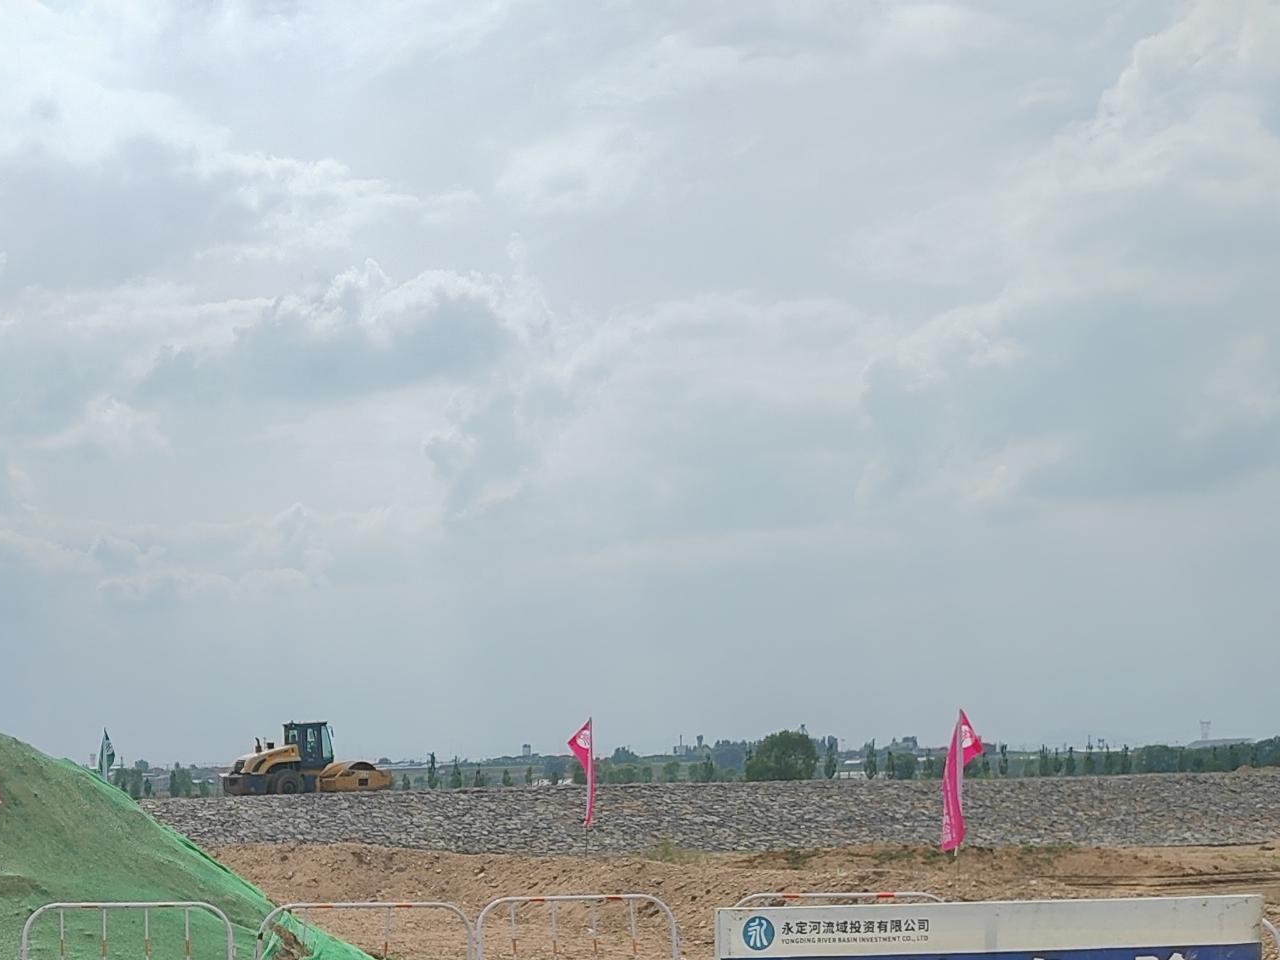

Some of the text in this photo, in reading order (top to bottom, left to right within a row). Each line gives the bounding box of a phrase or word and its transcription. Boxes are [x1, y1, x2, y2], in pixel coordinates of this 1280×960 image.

[781, 918, 930, 936] 永定河流域投资有限公司
